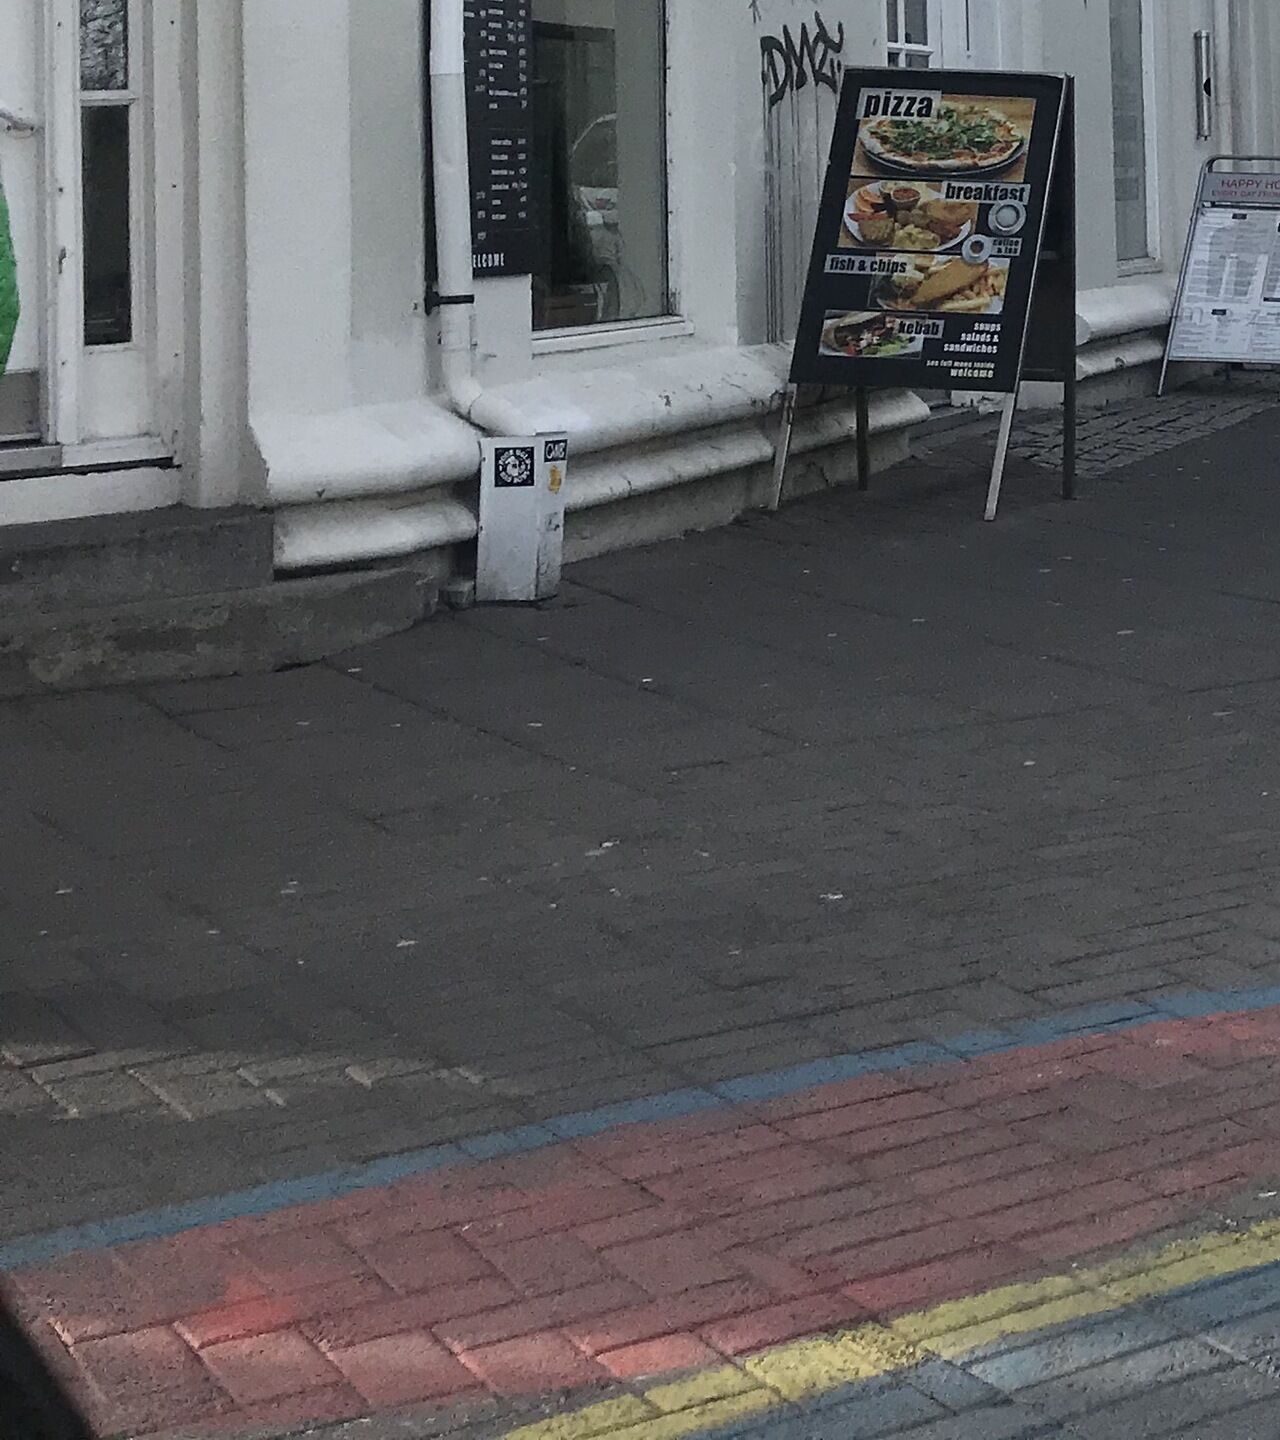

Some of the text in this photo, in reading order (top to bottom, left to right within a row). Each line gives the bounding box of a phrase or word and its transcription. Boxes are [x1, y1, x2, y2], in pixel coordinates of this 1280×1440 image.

[863, 91, 934, 118] pizza
[1222, 179, 1262, 189] HAPPY
[944, 184, 1026, 202] breakfast
[472, 253, 505, 268] ELCOME
[830, 258, 908, 275] fish & chips
[898, 320, 940, 336] kebab
[943, 342, 998, 354] sandwiches
[950, 368, 994, 378] welcome
